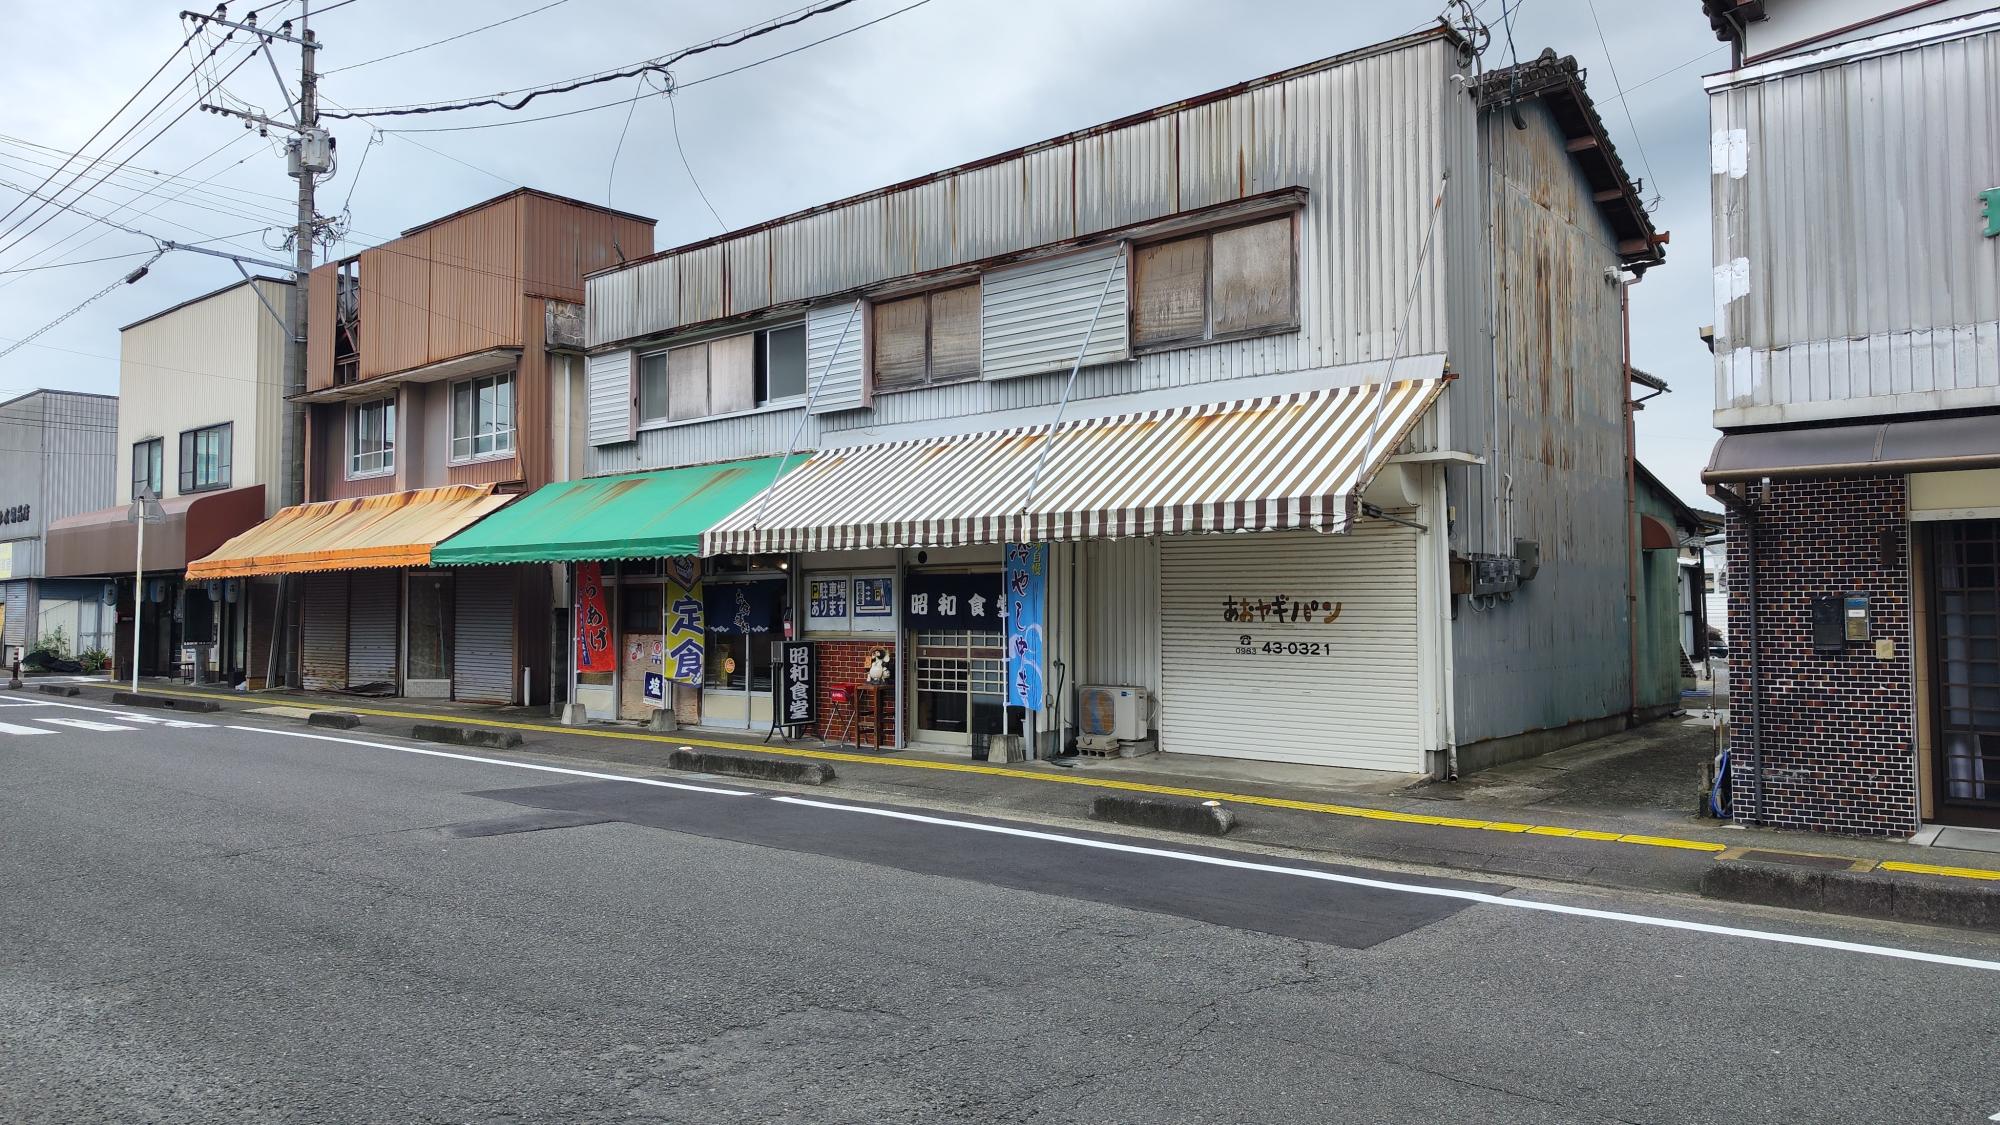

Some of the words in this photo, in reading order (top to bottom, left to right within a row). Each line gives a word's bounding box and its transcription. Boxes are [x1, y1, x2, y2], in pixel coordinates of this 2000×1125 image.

[584, 562, 609, 653] らあげ
[811, 600, 846, 617] あります
[1222, 594, 1342, 624] あおヤギパン
[670, 594, 705, 685] 定食
[1235, 646, 1257, 656] 0983
[1261, 641, 1331, 656] 43-0321
[648, 676, 662, 696] 塩
[789, 646, 809, 720] 昭和食堂
